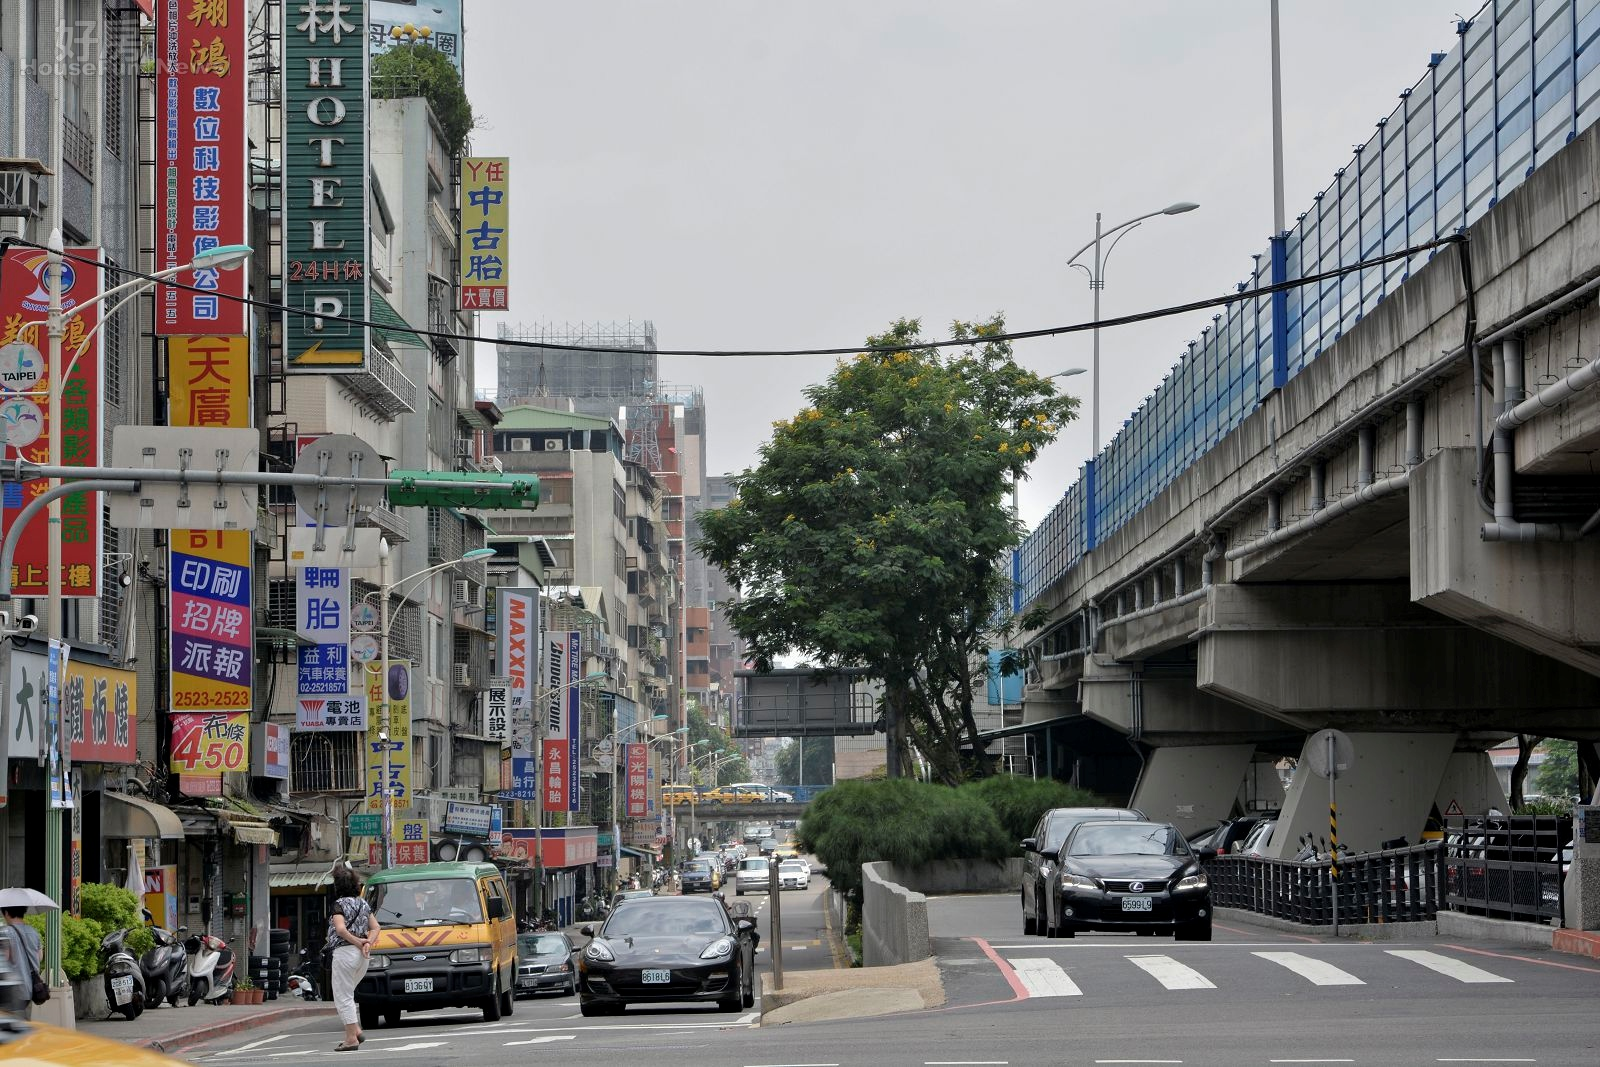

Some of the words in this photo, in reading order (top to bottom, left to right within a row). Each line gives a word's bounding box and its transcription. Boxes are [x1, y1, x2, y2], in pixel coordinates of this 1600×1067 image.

[306, 57, 346, 250] HOTEL
[465, 185, 504, 281] 中古胎
[313, 296, 343, 331] P
[2, 371, 37, 382] TAIPEI
[180, 559, 242, 598] 印刷
[180, 599, 243, 639] 招牌
[180, 639, 244, 680] 派報
[304, 646, 342, 665] 益利
[509, 598, 526, 690] MAXXIS
[299, 667, 347, 681] 汽車保養
[175, 690, 249, 707] 2523-2523
[327, 700, 360, 714] 電池
[203, 714, 245, 741] 布條
[325, 716, 361, 726] 專賣店
[173, 725, 244, 770] 450
[549, 748, 561, 803] 永昌輪胎
